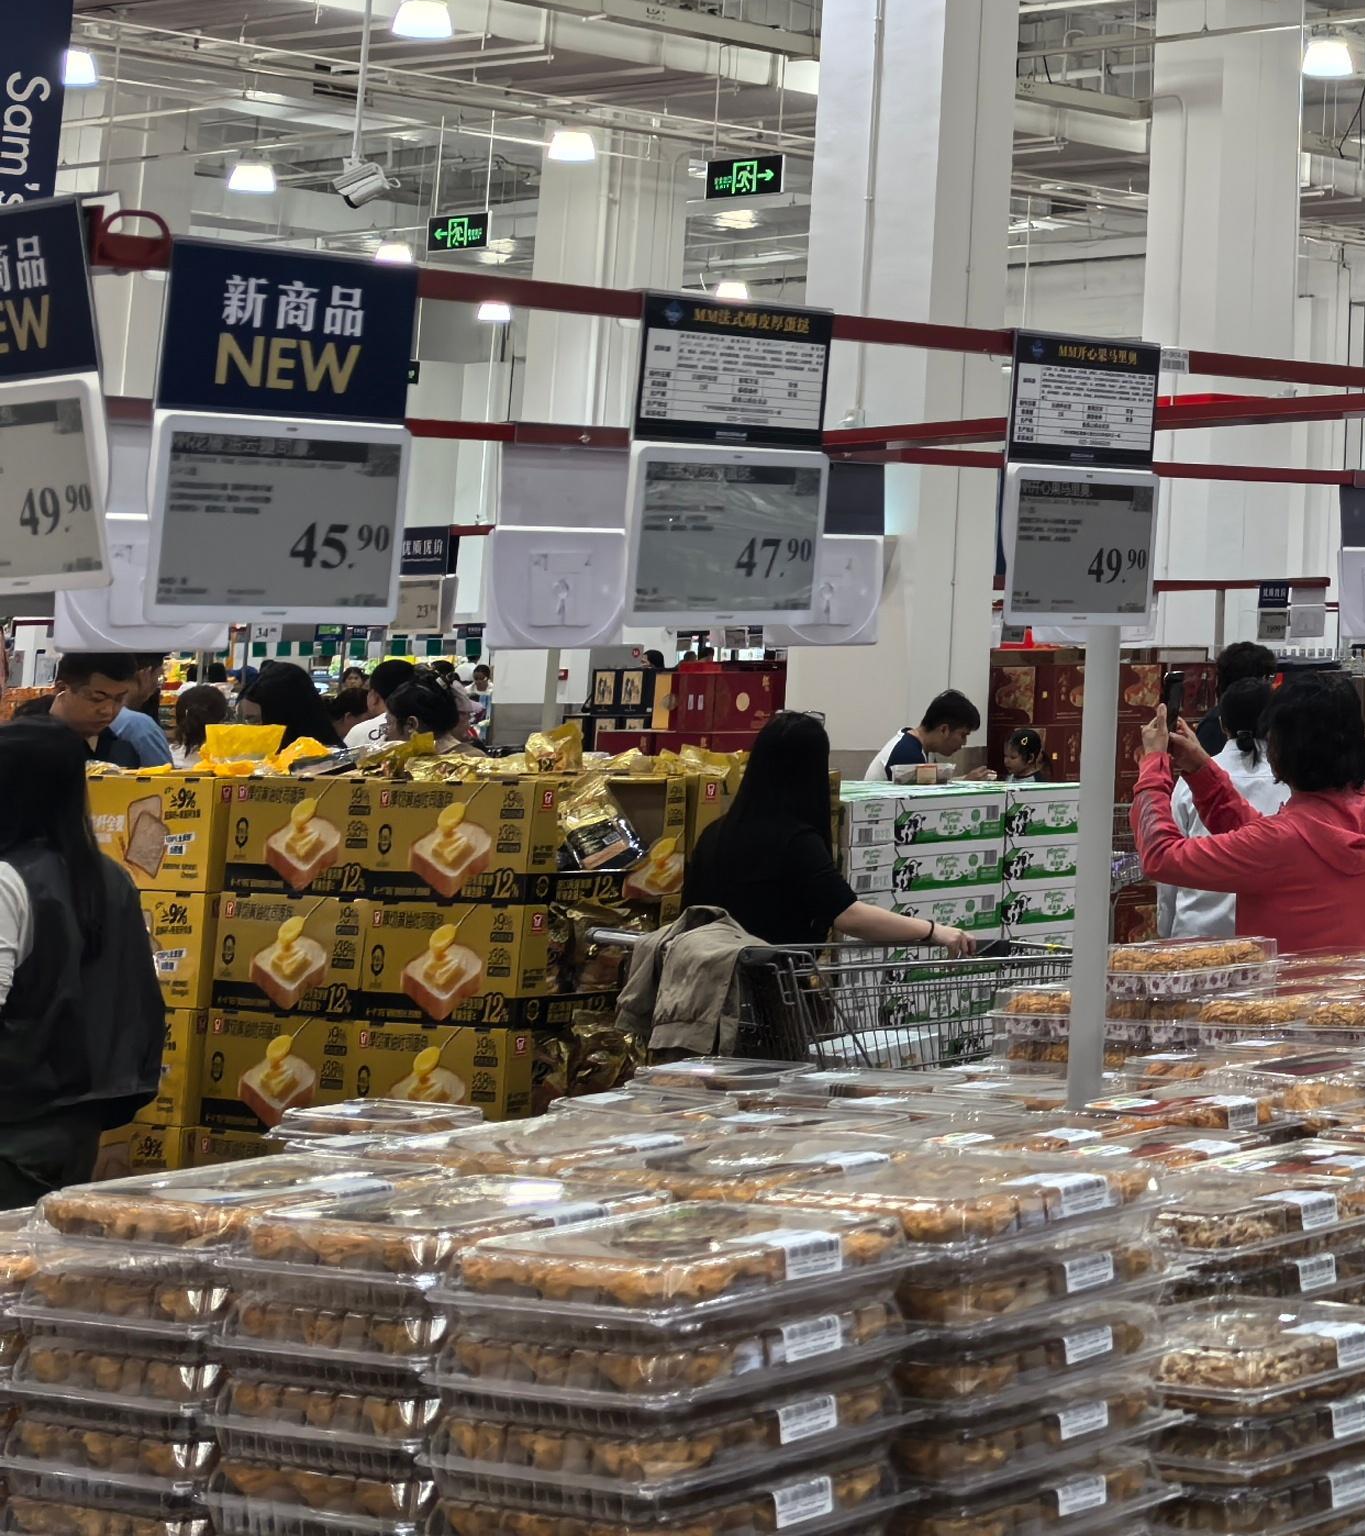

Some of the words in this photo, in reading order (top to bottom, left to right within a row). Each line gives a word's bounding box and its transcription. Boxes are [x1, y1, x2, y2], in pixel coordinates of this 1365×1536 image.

[222, 274, 365, 337] 新商品
[215, 332, 363, 395] NEW
[19, 483, 92, 536] 49.90
[289, 521, 391, 570] 45.90
[735, 537, 812, 579] 47.90
[1088, 547, 1147, 584] 49.90
